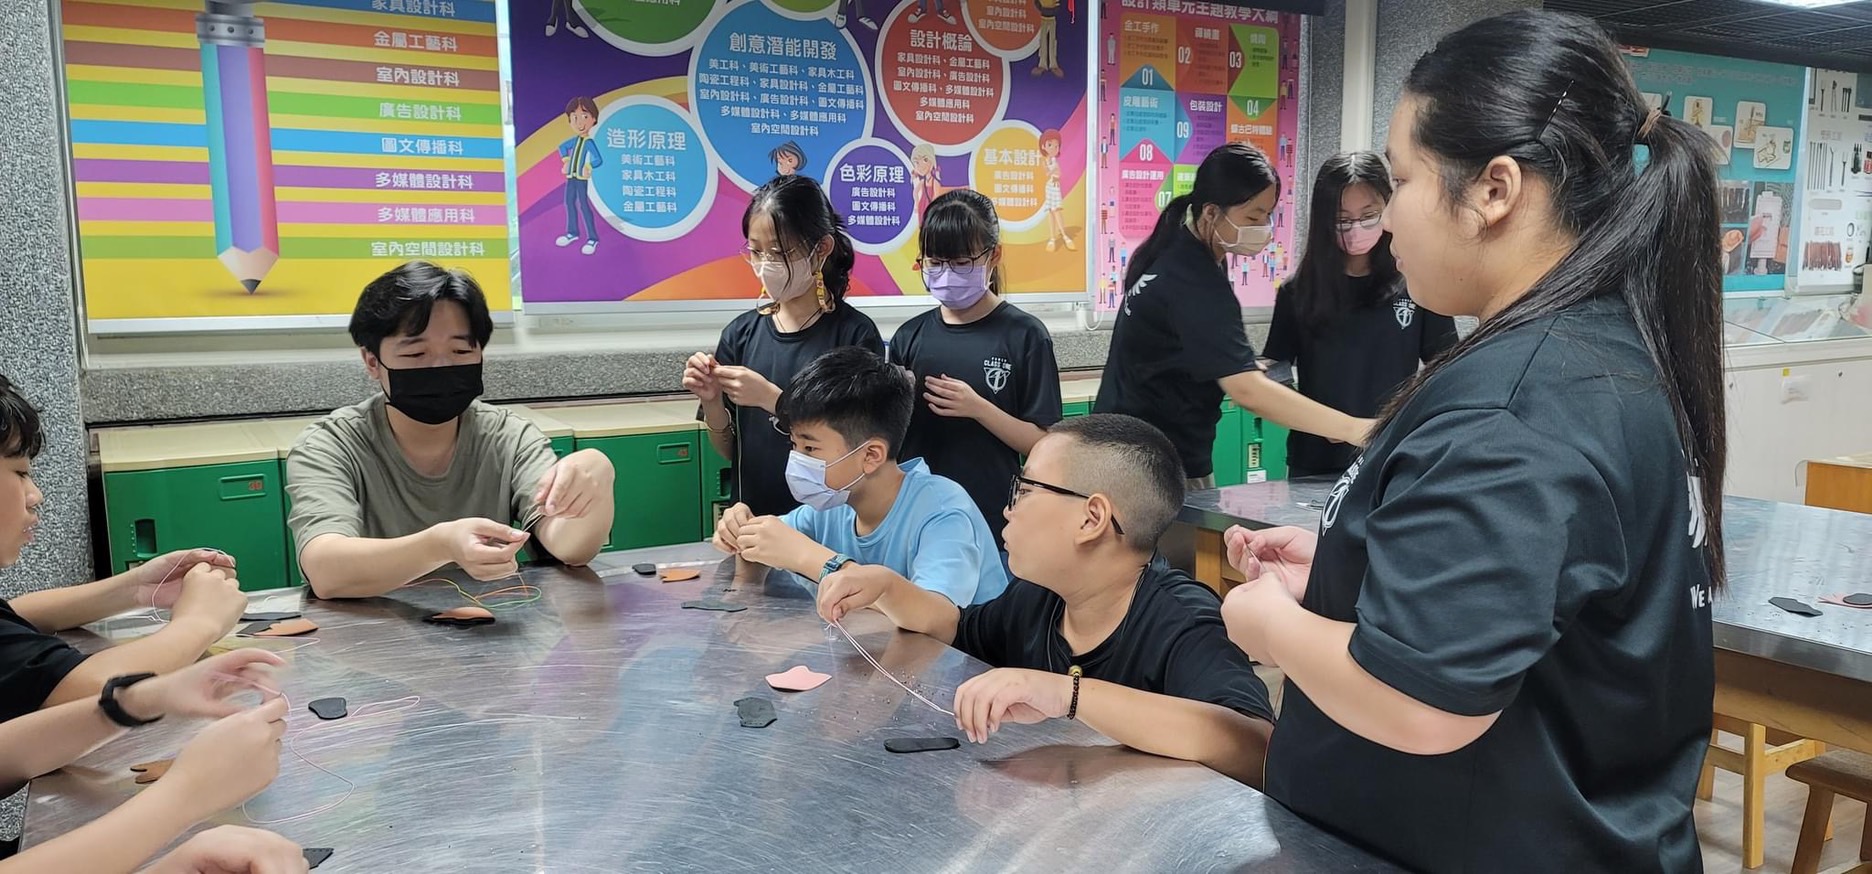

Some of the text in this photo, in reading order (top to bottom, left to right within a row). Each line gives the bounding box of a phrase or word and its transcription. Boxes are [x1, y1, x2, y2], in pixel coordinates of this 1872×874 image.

[374, 31, 458, 52] 金屬工藝科
[729, 32, 837, 61] 創意潛能開發
[910, 29, 972, 52] 設計概論
[1178, 47, 1191, 64] 02
[1229, 51, 1242, 68] 03
[376, 67, 460, 87] 室內設計科
[1142, 69, 1153, 86] 01
[379, 102, 461, 121] 廣告設計科
[1246, 100, 1259, 116] 04
[751, 122, 819, 136] 室內空間設計科
[1177, 121, 1189, 138] 09
[381, 137, 464, 155] 圖文傳播科
[606, 128, 687, 151] 造形原理
[621, 154, 676, 167] 美術工藝科
[984, 149, 1041, 166] 基本設計
[1139, 144, 1153, 161] 08
[375, 172, 474, 190] 多媒體設計科
[622, 169, 676, 182] 家具木工科
[839, 164, 905, 184] 色彩原理
[622, 185, 677, 198] 陶瓷工程科
[851, 187, 896, 198] 廣告設計科
[1158, 191, 1172, 207] 07
[377, 206, 475, 224] 多媒體應用科
[623, 200, 677, 213] 金屬工藝科
[852, 201, 896, 212] 圖文傳播科
[847, 215, 901, 226] 多媒體設計科
[371, 241, 485, 257] 室內空間設計科
[1689, 583, 1705, 611] WE
